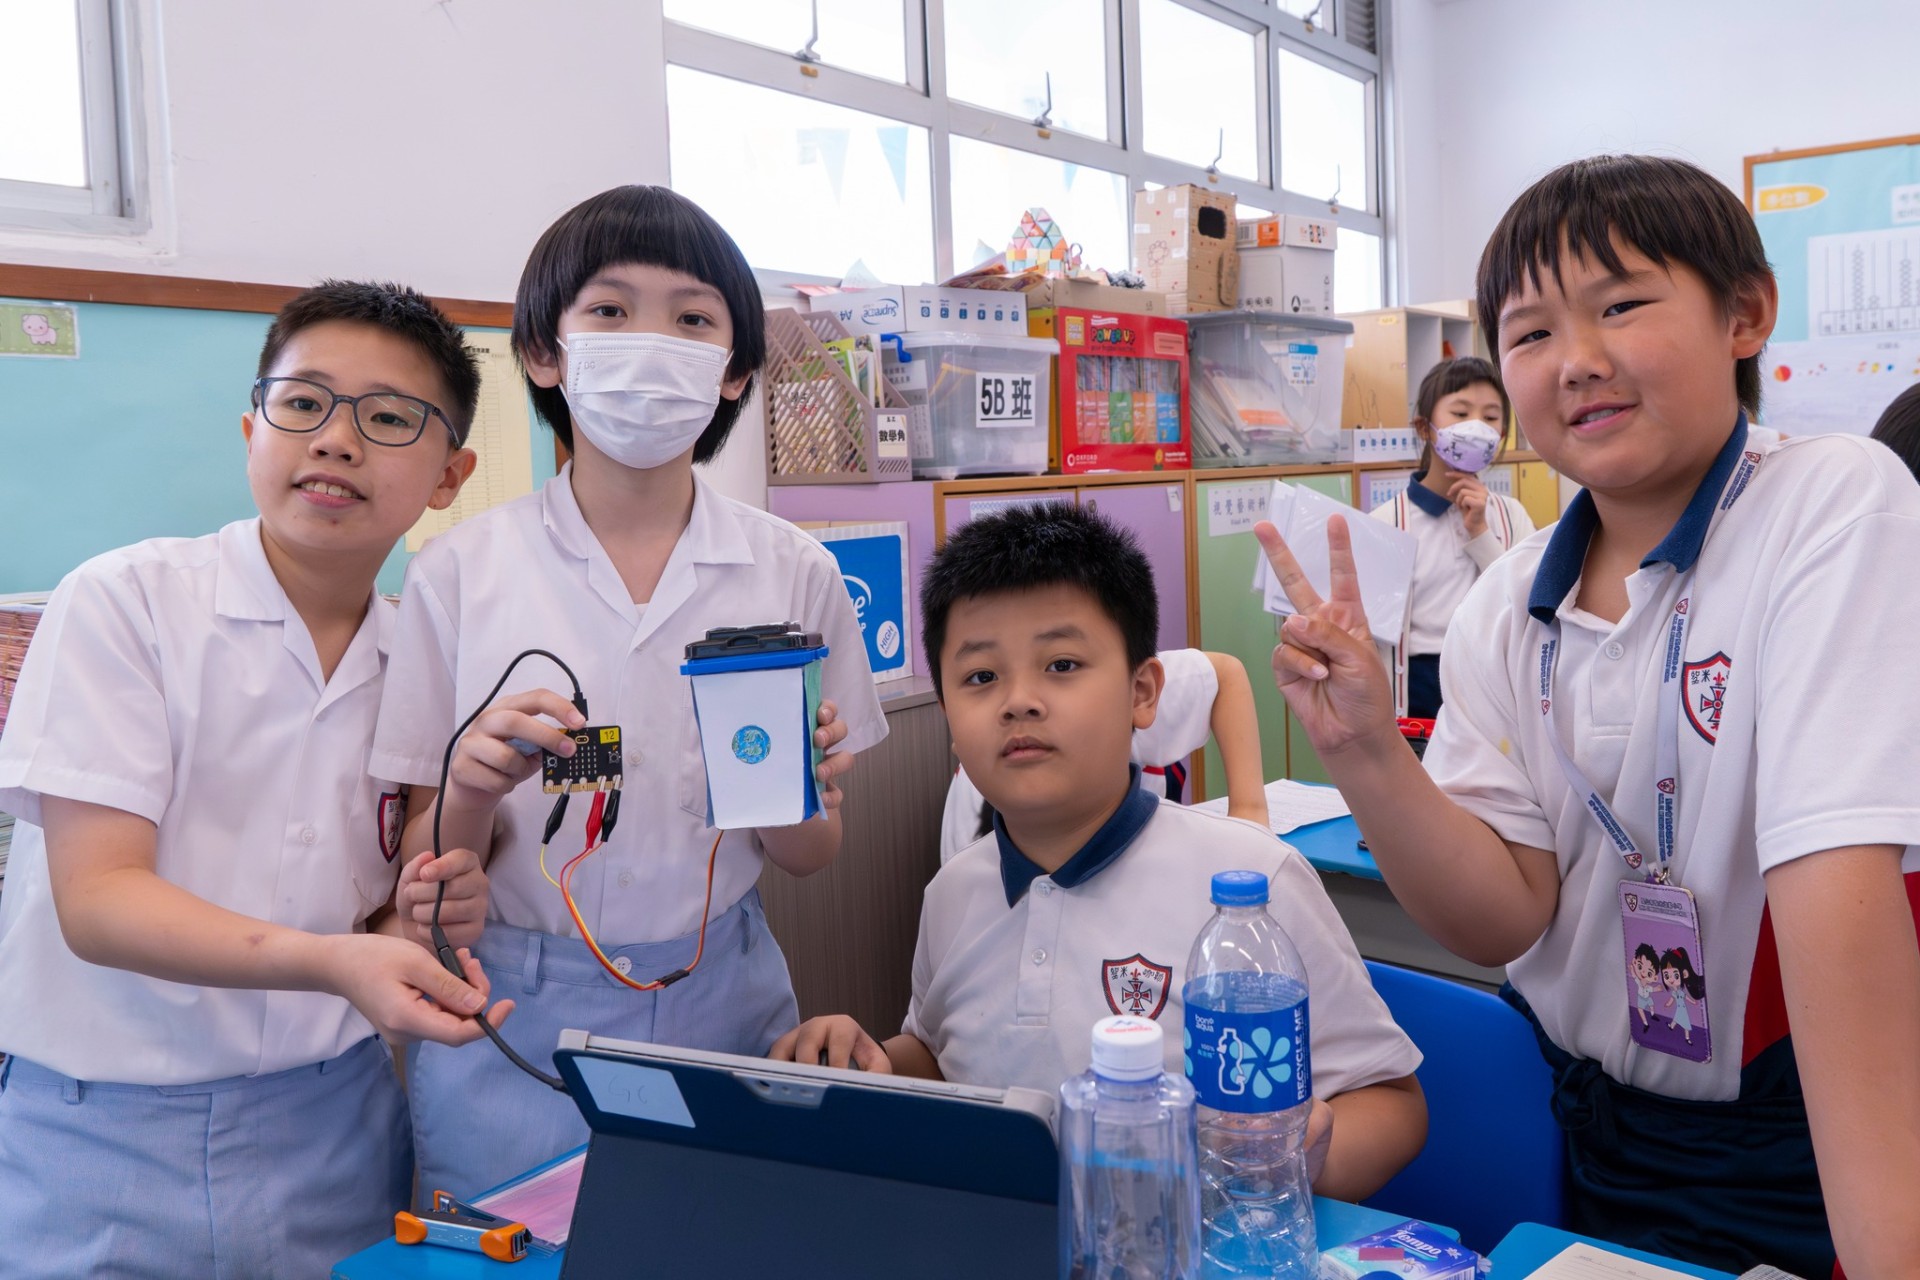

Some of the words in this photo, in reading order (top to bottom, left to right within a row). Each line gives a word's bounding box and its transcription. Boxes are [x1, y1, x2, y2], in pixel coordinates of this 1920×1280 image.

[1090, 327, 1122, 344] POWER
[981, 377, 1005, 416] 5B
[1011, 376, 1032, 419] 班
[878, 429, 906, 442] 數學角
[880, 625, 894, 649] HIGH
[604, 730, 614, 740] 12
[1293, 1006, 1305, 1032] ME
[1294, 1034, 1306, 1101] RECYCLE
[1391, 1229, 1442, 1256] Tempo
